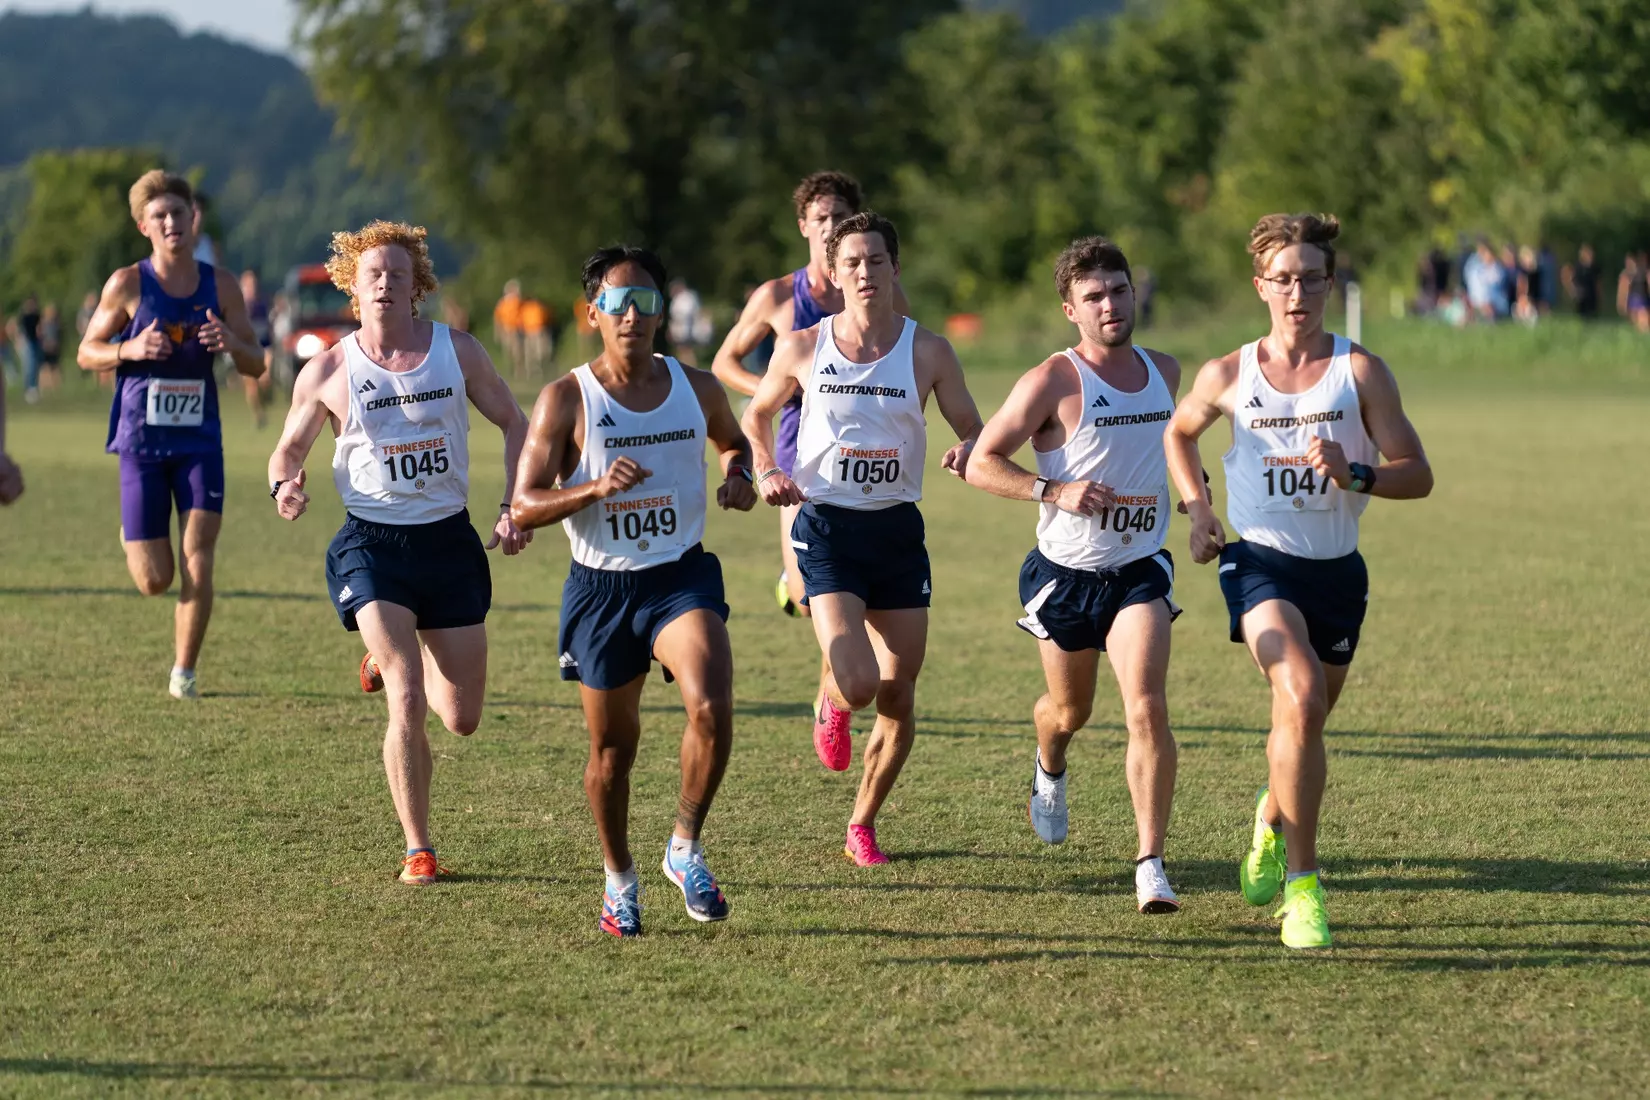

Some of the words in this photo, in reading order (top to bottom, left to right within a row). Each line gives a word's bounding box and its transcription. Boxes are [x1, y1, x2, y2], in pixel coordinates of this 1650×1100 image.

[366, 387, 453, 411] CHATTANOOGA
[818, 384, 906, 398] CHATTANOOGA
[152, 394, 201, 414] 1072
[1094, 410, 1172, 427] CHATTANOOGA
[1250, 410, 1344, 429] CHATTANOOGA
[382, 437, 446, 455] TENNESSEE
[604, 428, 695, 448] CHATTANOOGA
[839, 447, 899, 459] TENNESSEE
[1262, 456, 1309, 467] TENNES
[384, 448, 449, 481] 1045
[838, 458, 900, 484] 1050
[604, 495, 673, 513] TENNESSEE
[1113, 495, 1158, 506] NNESSEE
[606, 507, 676, 540] 1049
[1100, 506, 1156, 533] 1046
